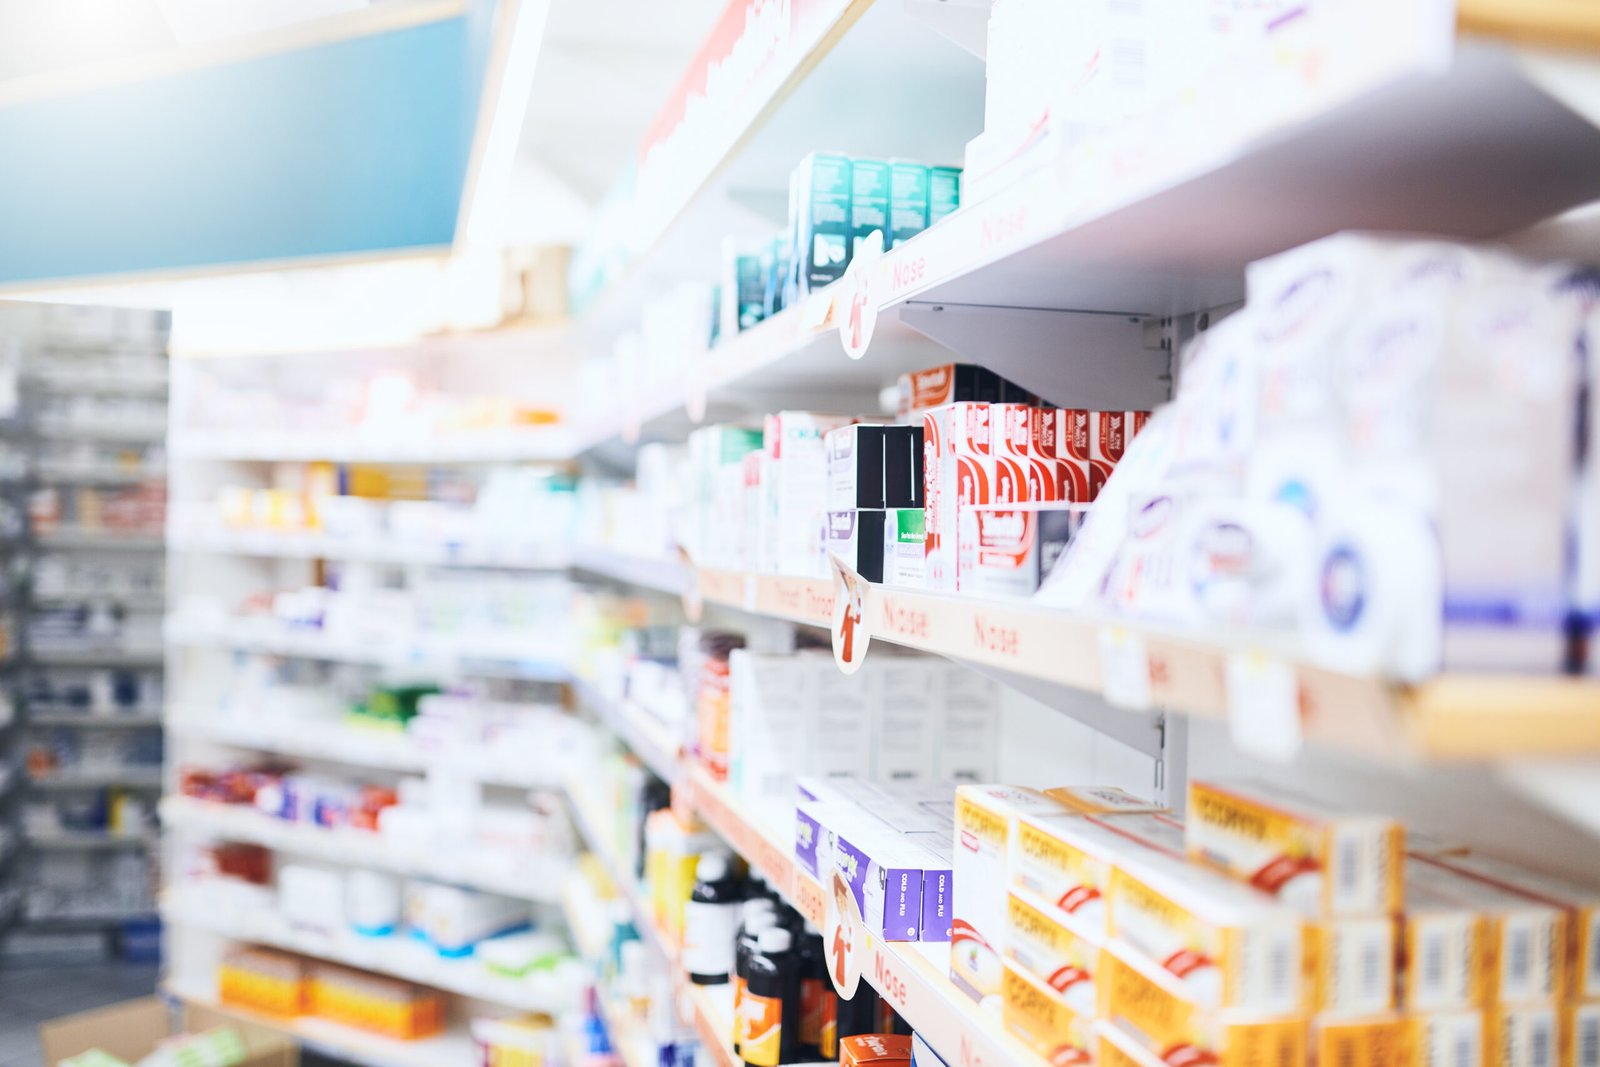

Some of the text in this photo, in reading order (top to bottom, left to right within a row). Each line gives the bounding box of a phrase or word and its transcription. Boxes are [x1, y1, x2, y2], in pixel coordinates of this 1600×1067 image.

[892, 257, 927, 292] Nose
[882, 596, 929, 638] Nose
[974, 614, 1020, 657] Nose
[874, 950, 907, 1006] Nose
